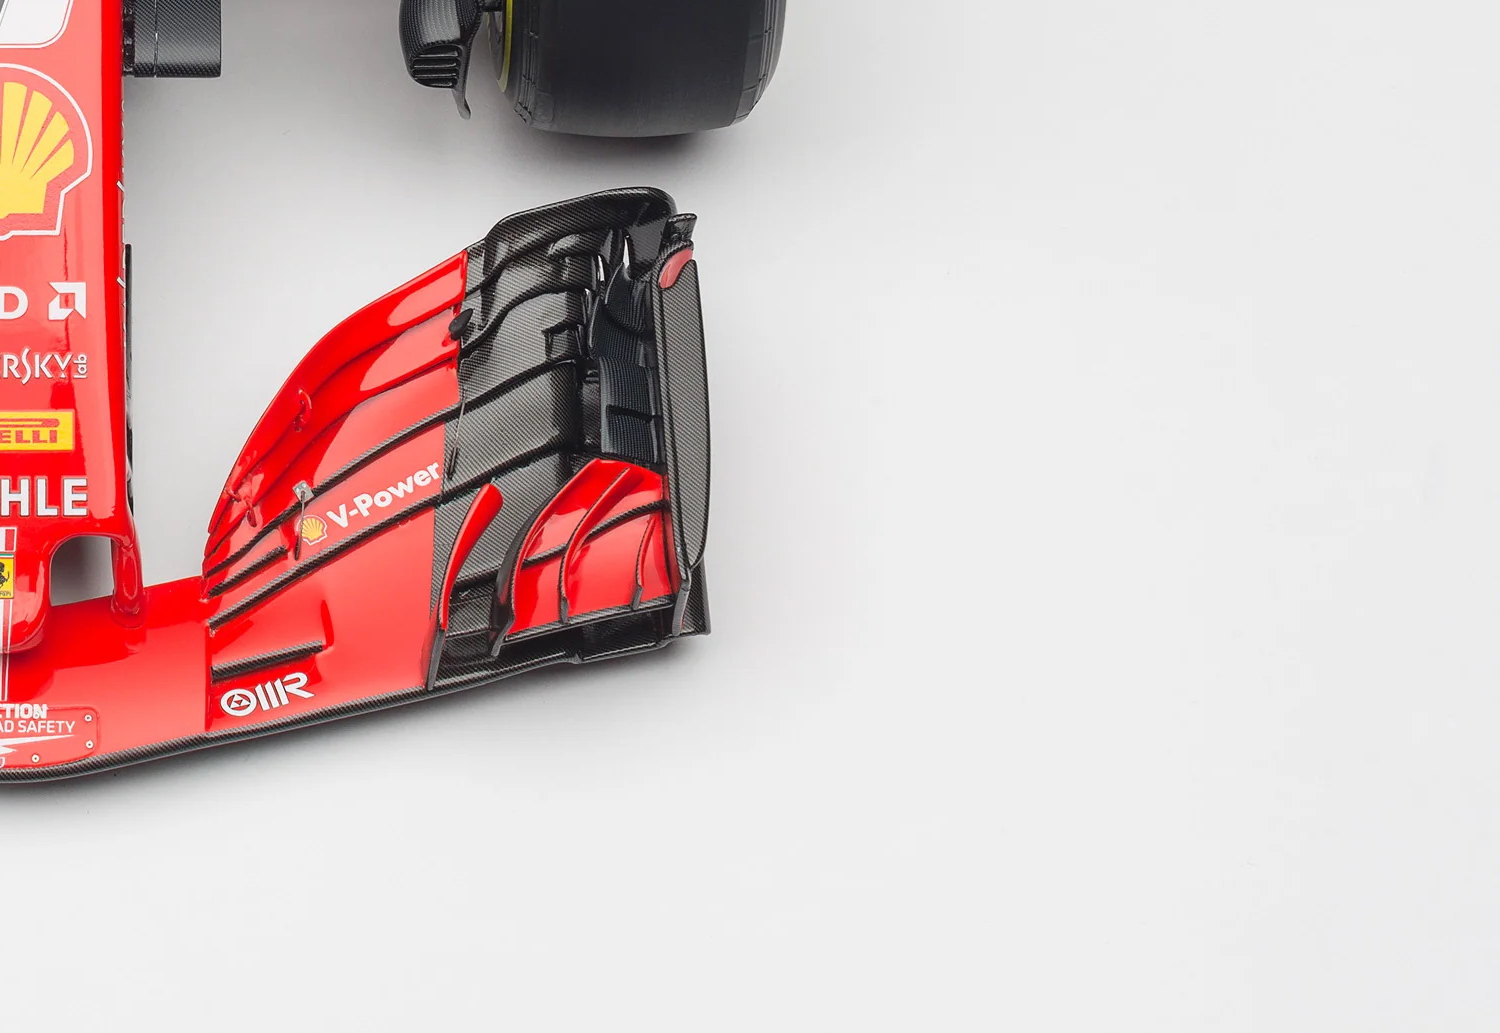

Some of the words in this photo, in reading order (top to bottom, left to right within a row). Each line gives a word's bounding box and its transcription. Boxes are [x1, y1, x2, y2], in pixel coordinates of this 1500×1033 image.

[73, 354, 88, 379] lab
[327, 462, 440, 529] V-Power
[18, 720, 75, 733] SAFETY
